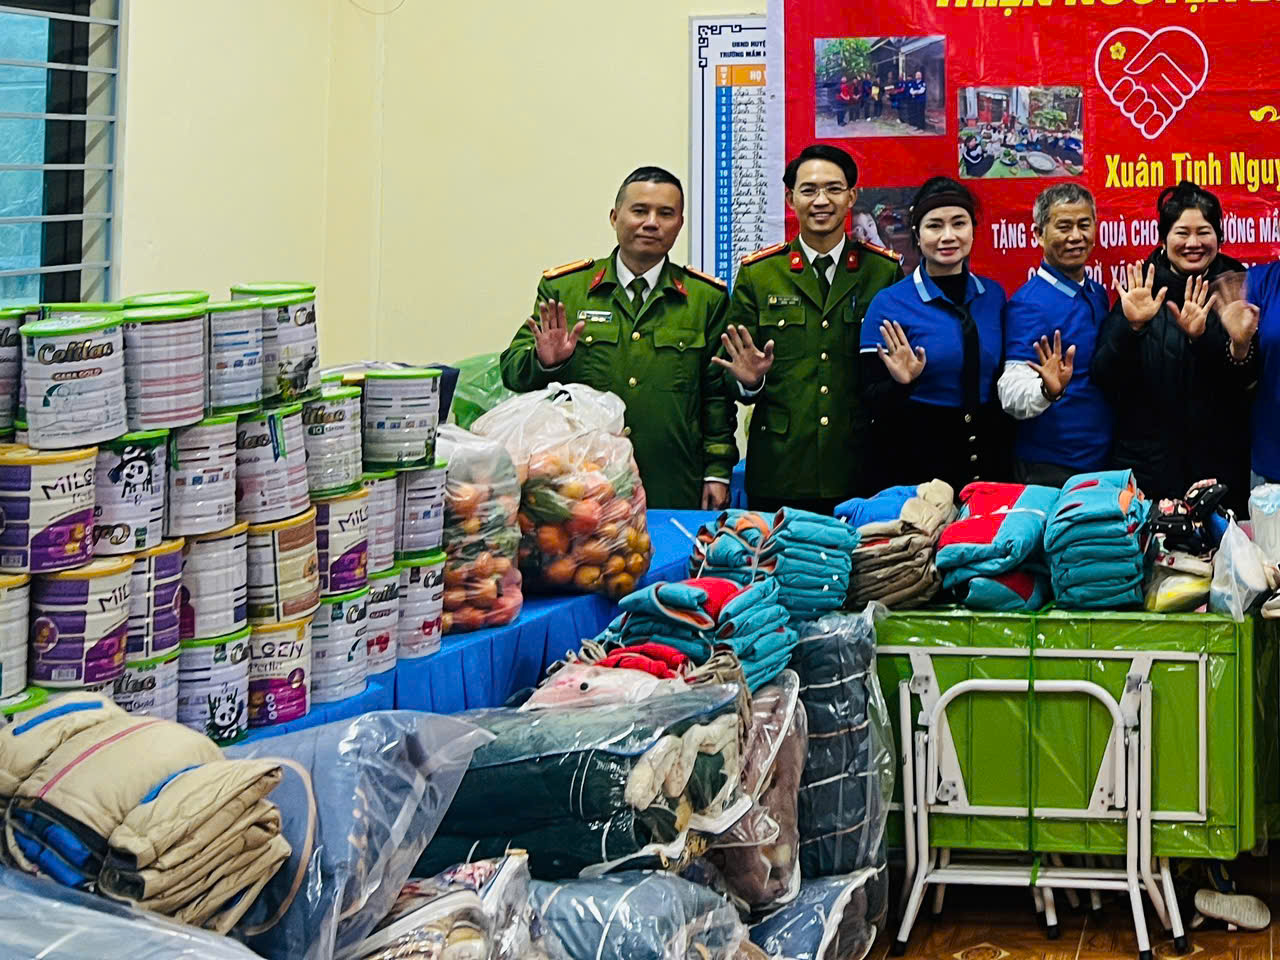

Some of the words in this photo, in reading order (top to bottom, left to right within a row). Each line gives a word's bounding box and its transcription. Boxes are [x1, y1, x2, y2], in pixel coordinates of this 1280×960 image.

[1105, 153, 1164, 188] Xuân
[1171, 152, 1222, 186] Tình
[991, 218, 1026, 254] TẶNG
[1100, 214, 1127, 248] QUÀ
[1131, 218, 1160, 247] CHO
